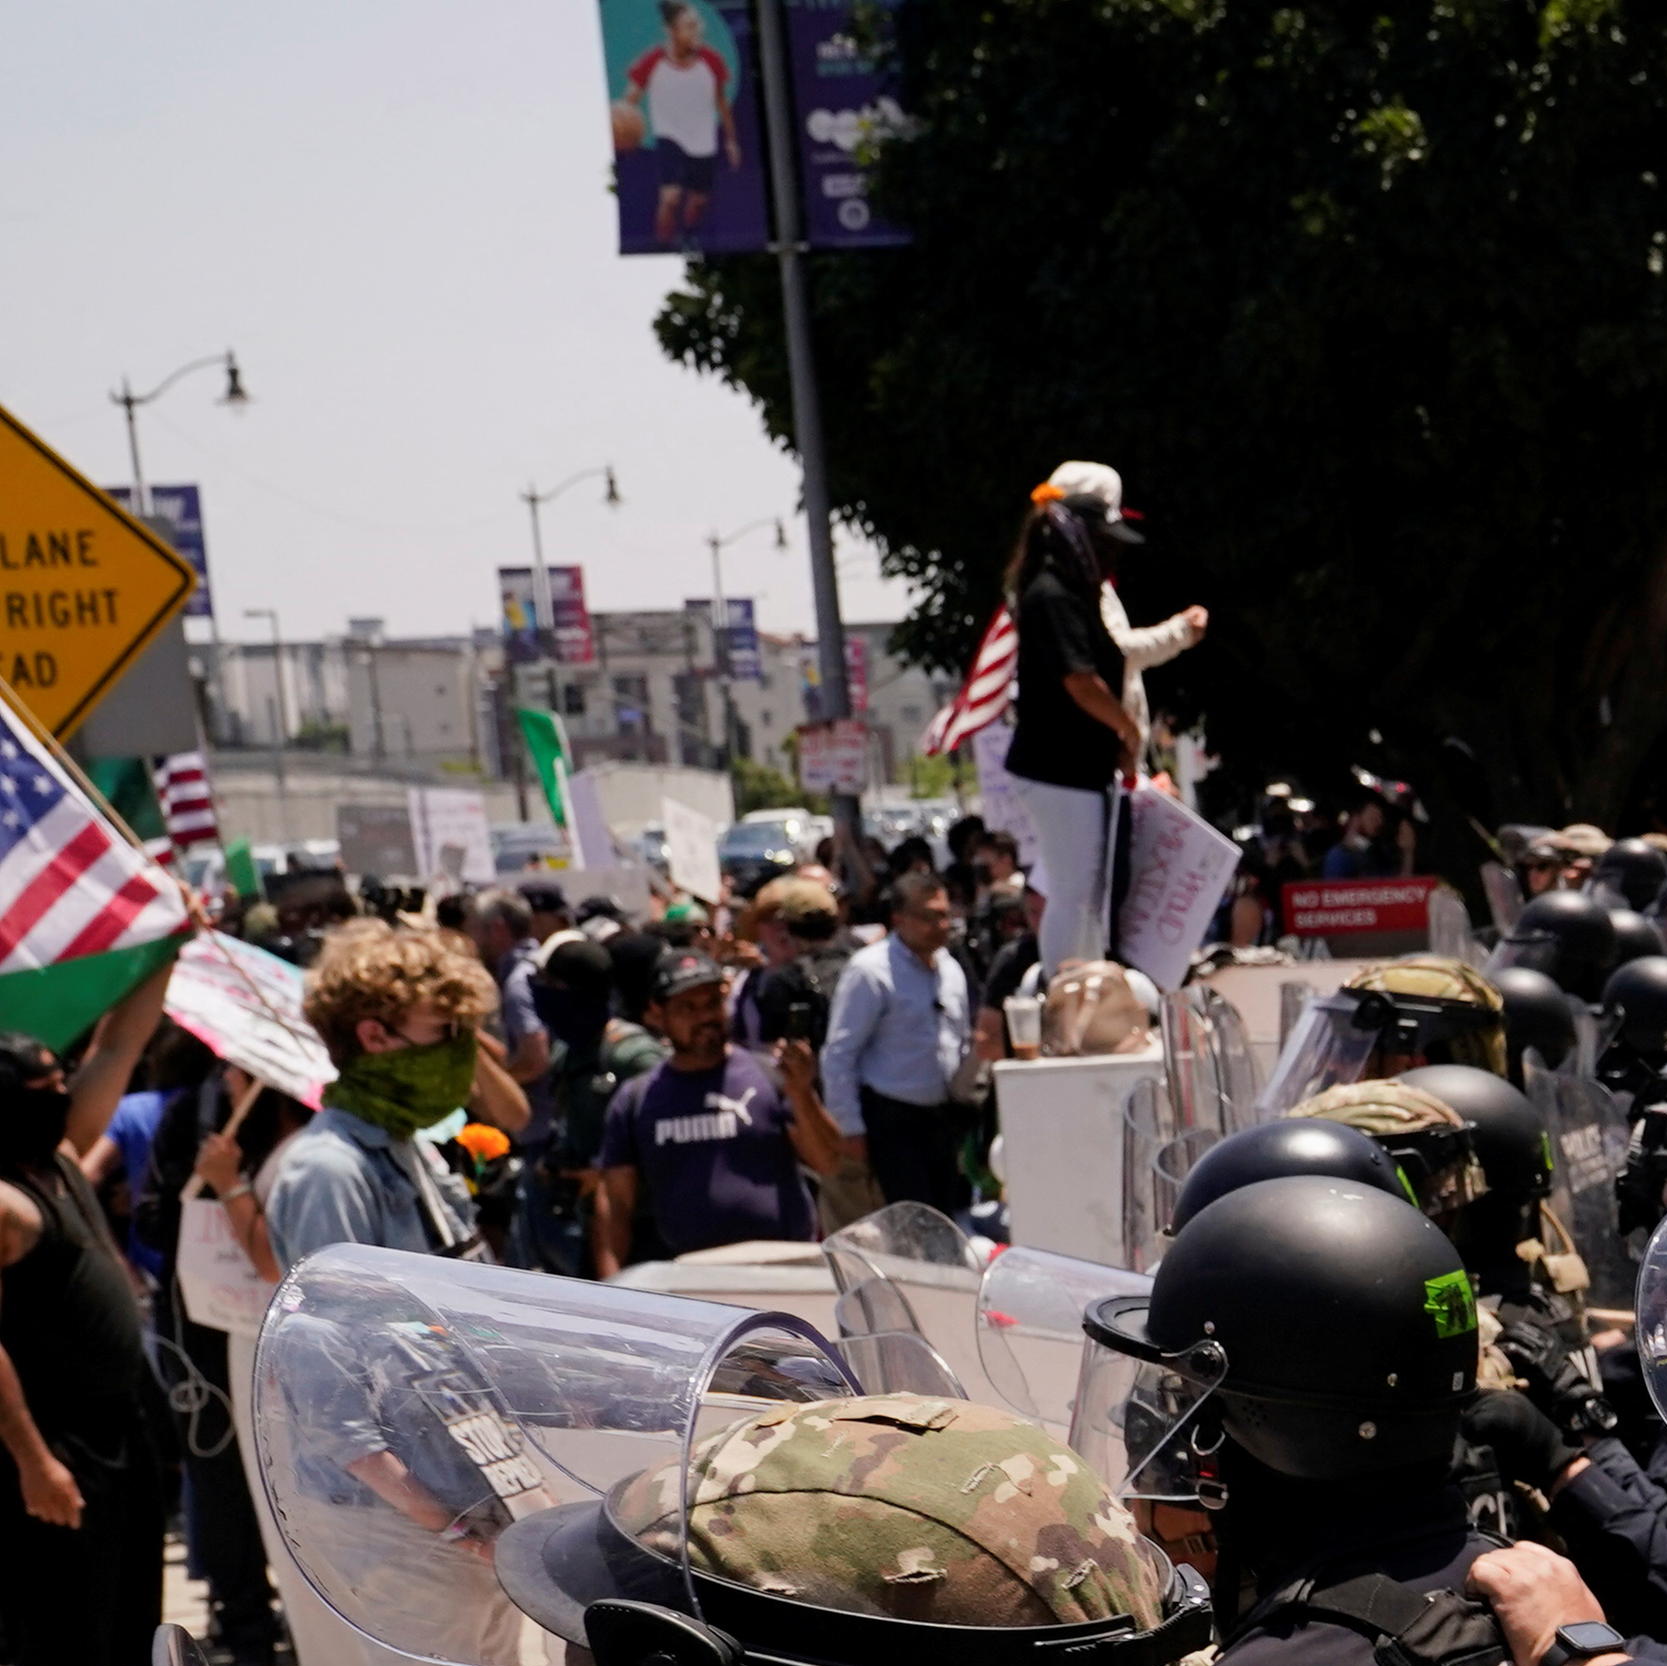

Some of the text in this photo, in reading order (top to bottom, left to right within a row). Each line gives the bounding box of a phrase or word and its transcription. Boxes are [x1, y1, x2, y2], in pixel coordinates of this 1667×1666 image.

[0, 529, 98, 569] LANE
[6, 587, 119, 628] RIGHT
[0, 651, 57, 688] AD
[1292, 886, 1427, 908] NO EMERGENCY
[1294, 908, 1377, 928] SERVICES
[655, 1111, 737, 1145] PUMA
